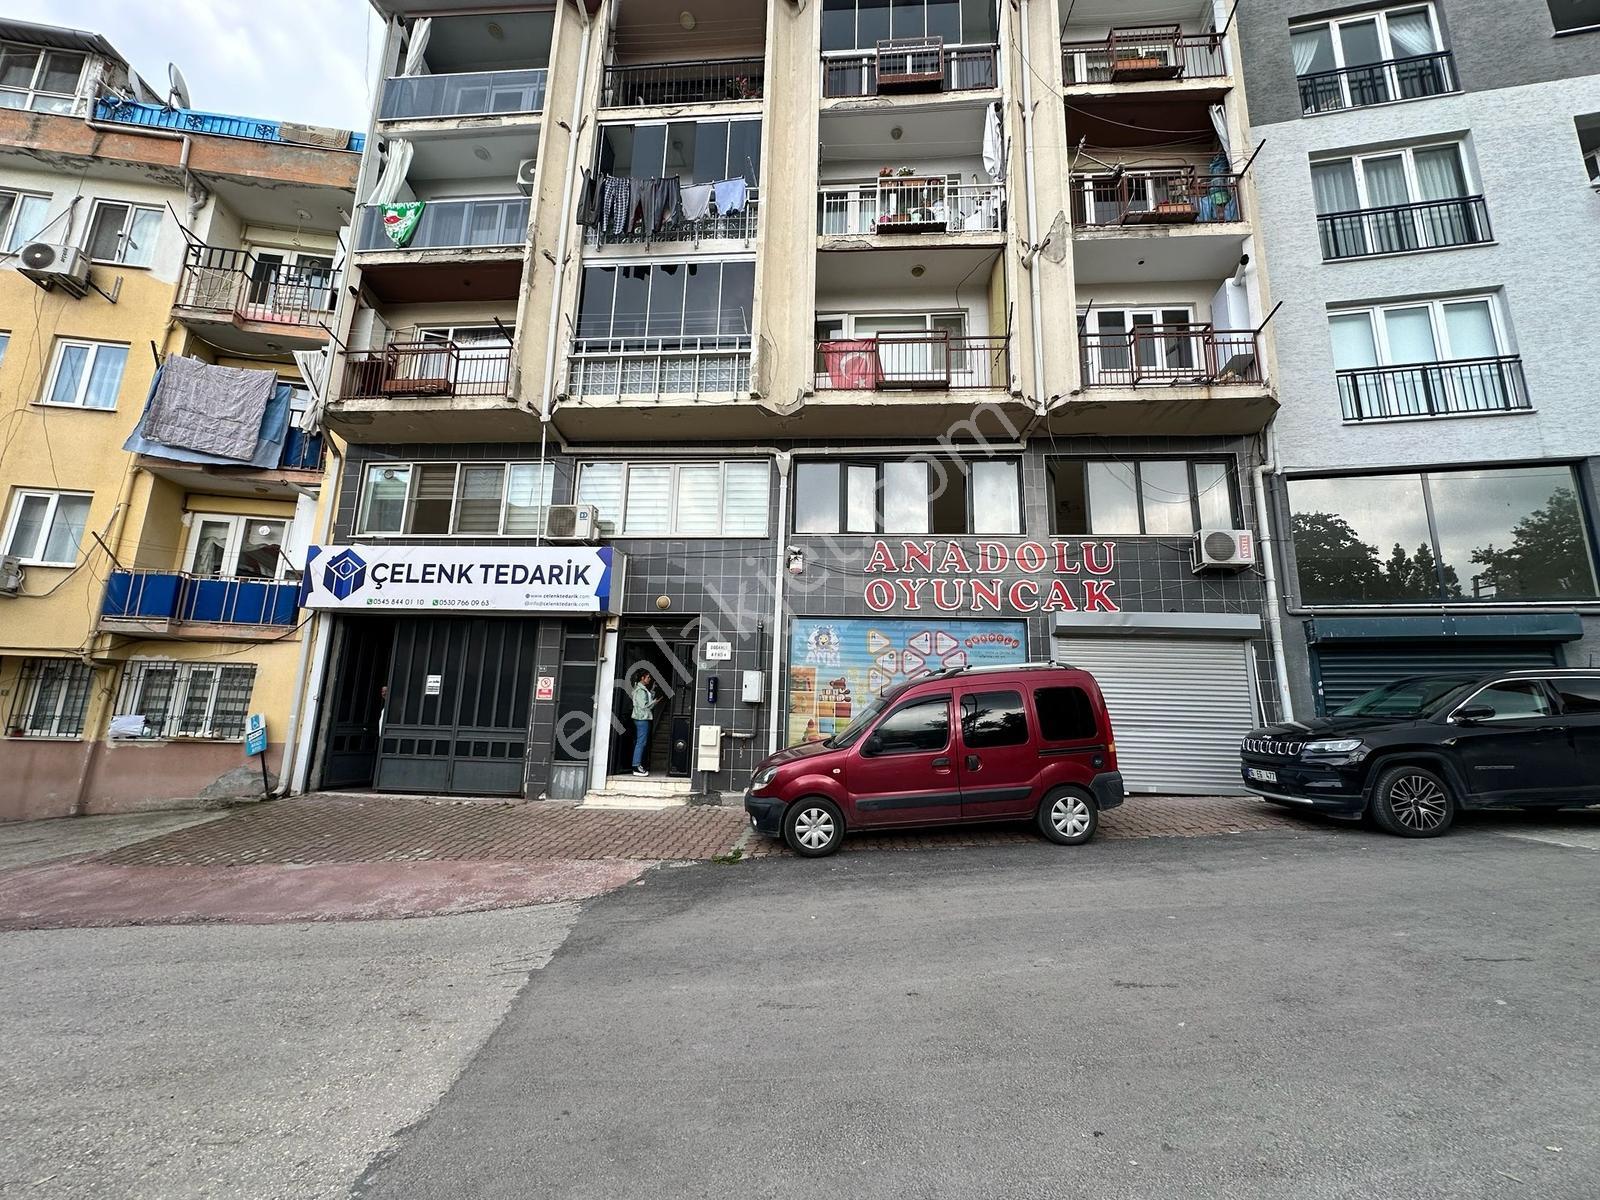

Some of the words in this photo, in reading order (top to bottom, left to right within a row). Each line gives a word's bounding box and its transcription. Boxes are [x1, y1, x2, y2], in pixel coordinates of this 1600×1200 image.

[864, 540, 1117, 575] ANADOLU
[1241, 536, 1249, 558] VESTEL
[370, 562, 475, 590] ÇELENK
[479, 559, 592, 586] TEDARİK
[864, 578, 1121, 612] OYUNCAK
